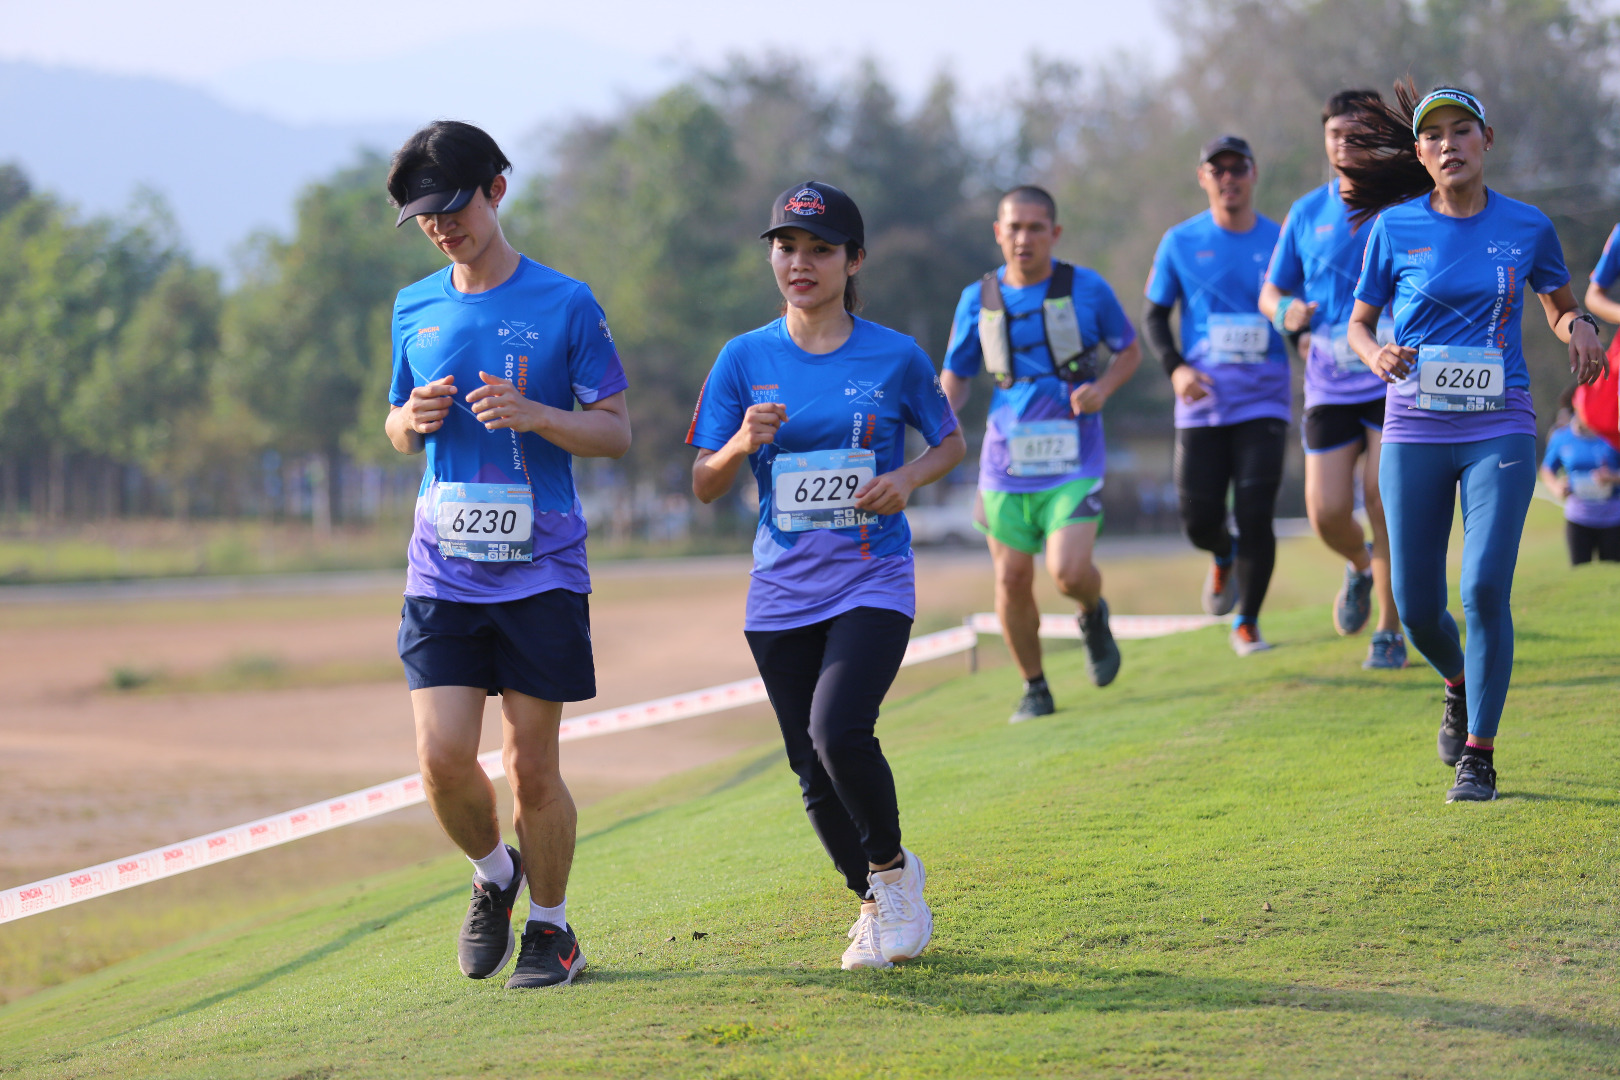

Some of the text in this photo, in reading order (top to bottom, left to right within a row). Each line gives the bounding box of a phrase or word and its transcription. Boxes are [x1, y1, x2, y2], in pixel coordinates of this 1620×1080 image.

[785, 197, 825, 214] Superdry
[1496, 265, 1506, 295] CROSS
[1506, 266, 1516, 305] SINGHA
[1487, 296, 1504, 338] COUNTRY
[418, 325, 440, 334] SINGHA
[497, 328, 540, 340] SP XC
[517, 355, 528, 396] SINGH
[1435, 367, 1491, 390] 6260
[844, 388, 885, 399] SP XC
[1485, 401, 1496, 412] 16
[851, 411, 863, 449] CROSS
[512, 447, 522, 470] RUN
[1024, 437, 1065, 458] 6172
[794, 474, 860, 504] 6229
[452, 508, 517, 535] 6230
[856, 512, 868, 526] 16
[510, 548, 522, 561] 16
[20, 887, 43, 901] SINGHA
